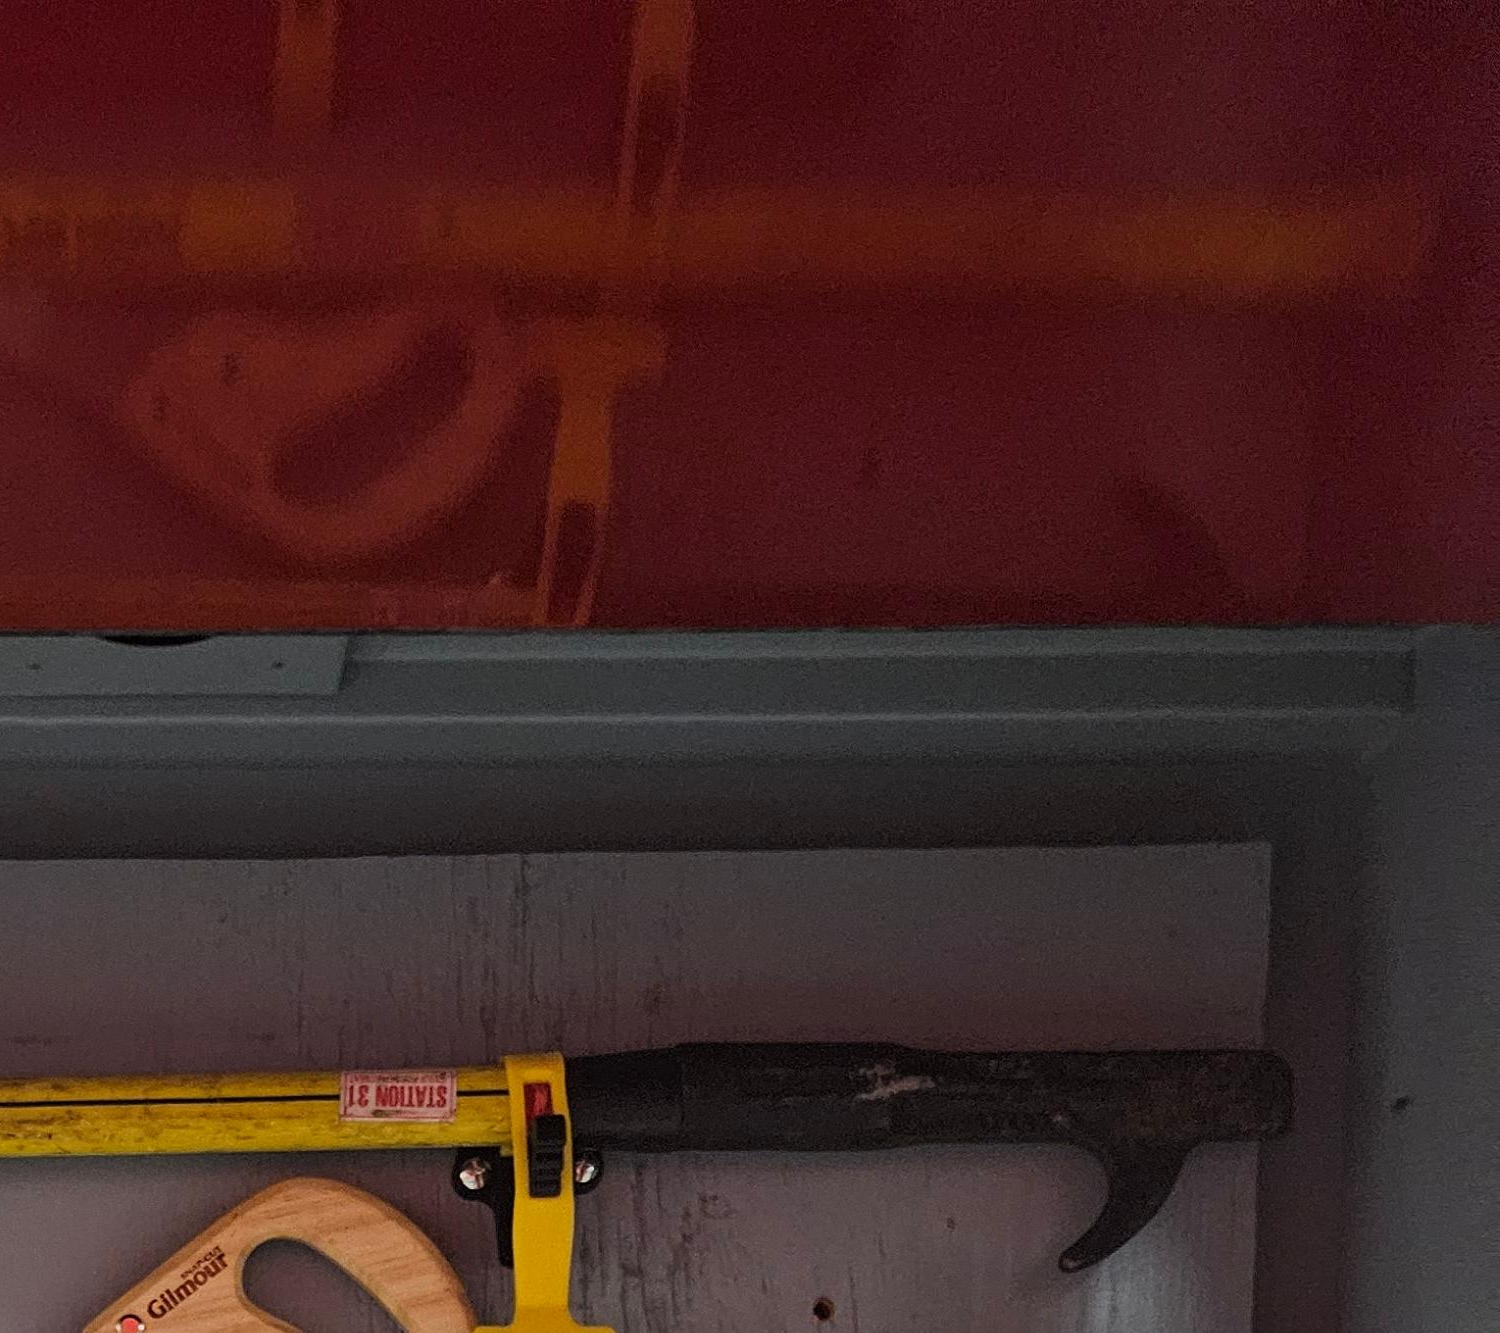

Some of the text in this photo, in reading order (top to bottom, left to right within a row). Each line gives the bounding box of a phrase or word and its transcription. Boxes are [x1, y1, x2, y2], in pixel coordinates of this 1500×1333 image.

[348, 1084, 448, 1109] STATION 31
[147, 1252, 228, 1319] Gilmour
